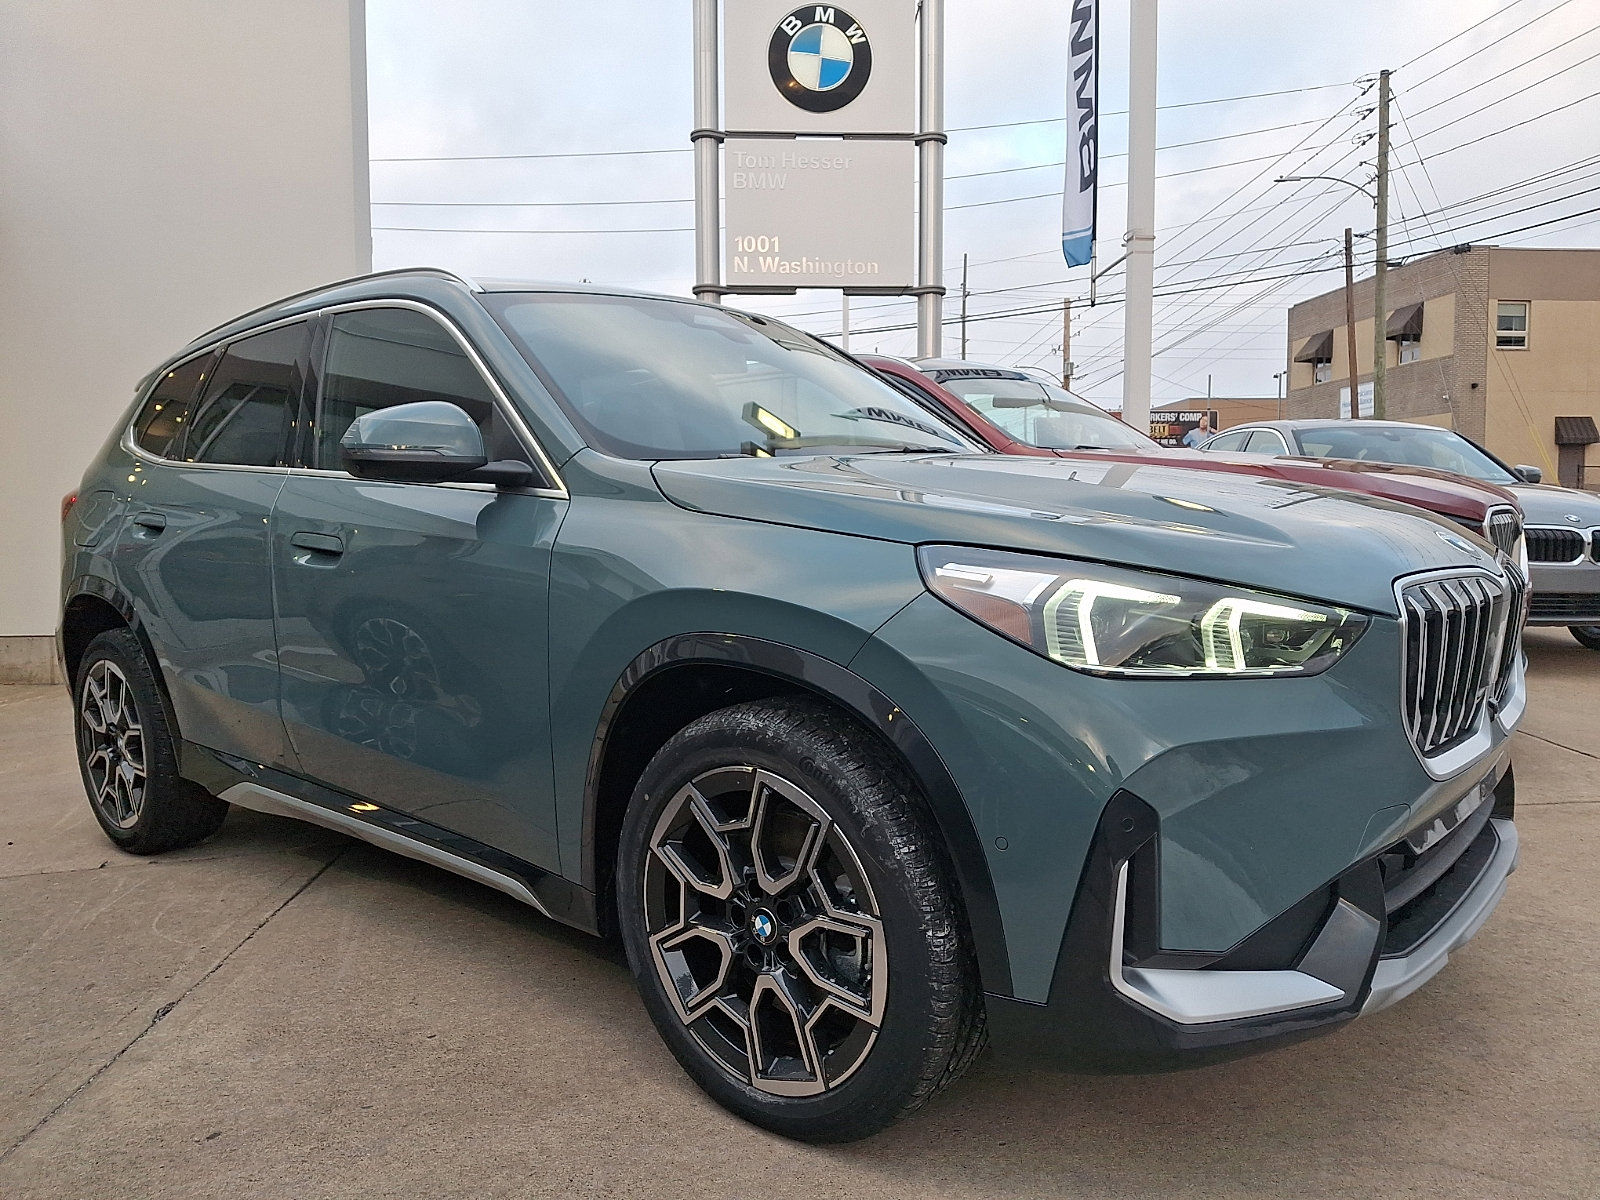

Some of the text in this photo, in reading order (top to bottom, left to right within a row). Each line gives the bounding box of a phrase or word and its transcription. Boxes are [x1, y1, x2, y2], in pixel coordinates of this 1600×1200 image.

[781, 6, 867, 45] BMW
[733, 152, 852, 169] Tom Hesser
[733, 173, 787, 189] BMW
[734, 236, 779, 253] 1001
[734, 256, 879, 277] N. Washington
[1179, 412, 1202, 422] COMP
